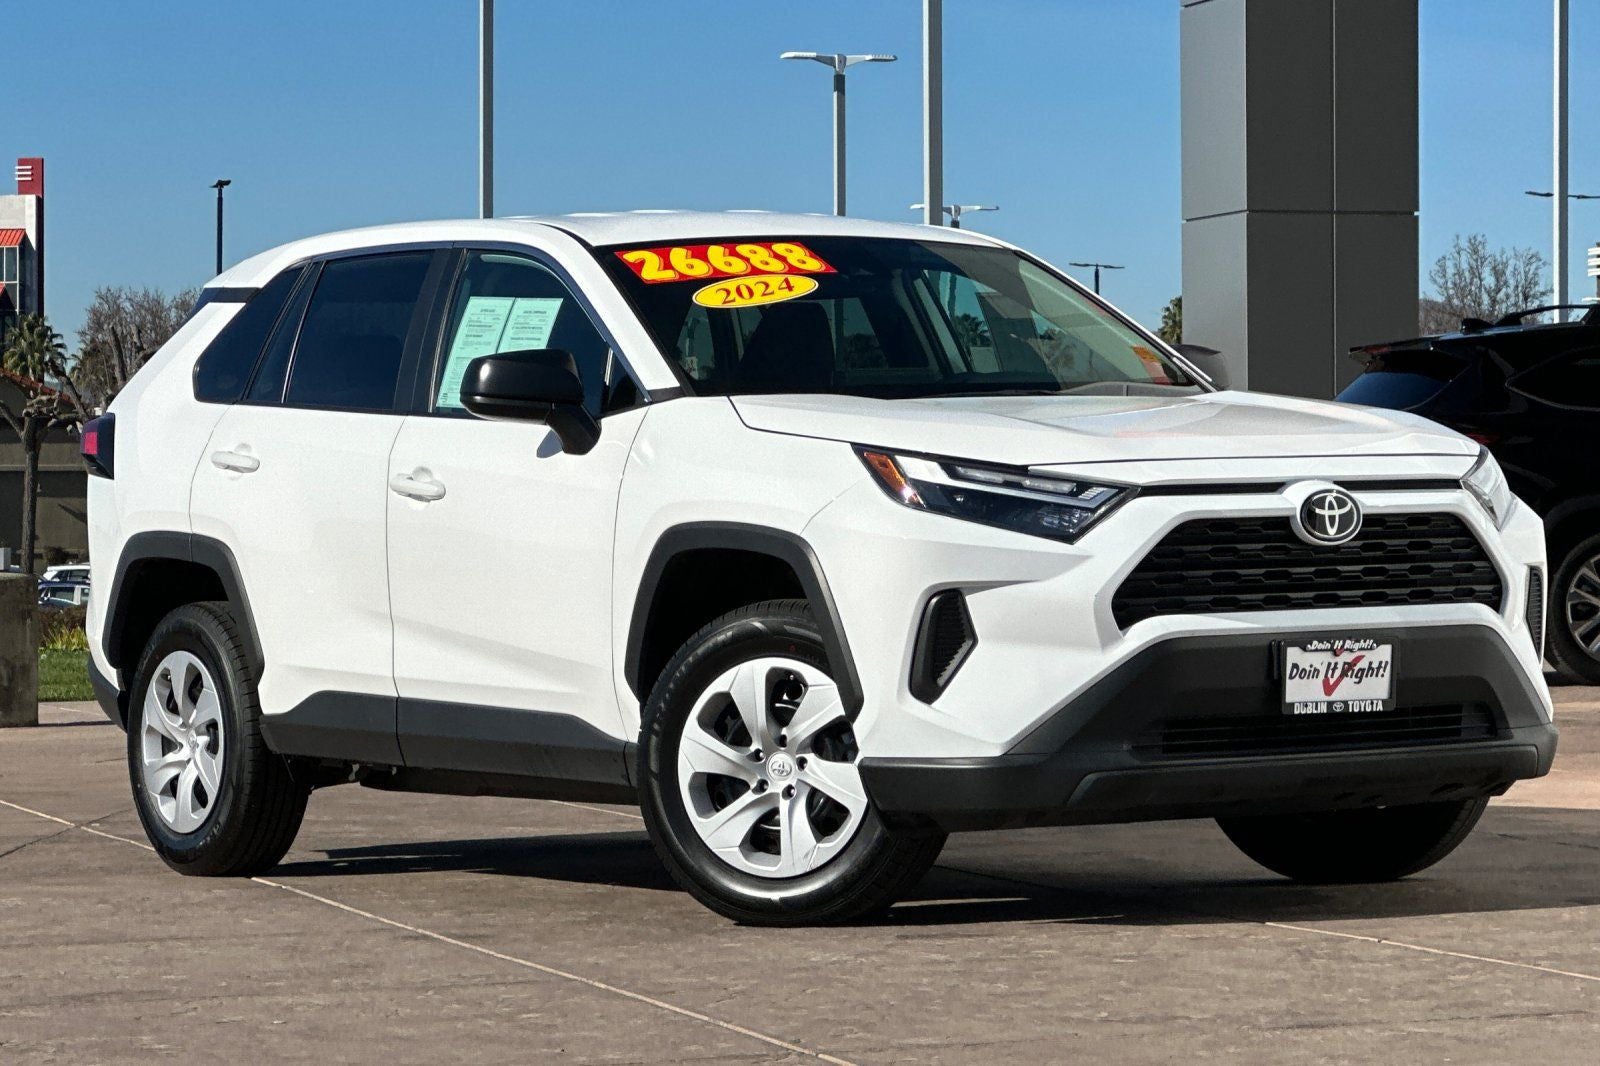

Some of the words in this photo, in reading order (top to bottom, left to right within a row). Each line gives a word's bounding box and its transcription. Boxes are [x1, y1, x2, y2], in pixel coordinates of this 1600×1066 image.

[622, 242, 825, 282] 26688
[715, 277, 795, 305] 2024
[1288, 661, 1324, 680] Doin'
[1324, 661, 1339, 678] It
[1341, 660, 1389, 684] Right!
[1293, 702, 1328, 715] DUBLIN
[1347, 700, 1384, 712] TOYOTA
